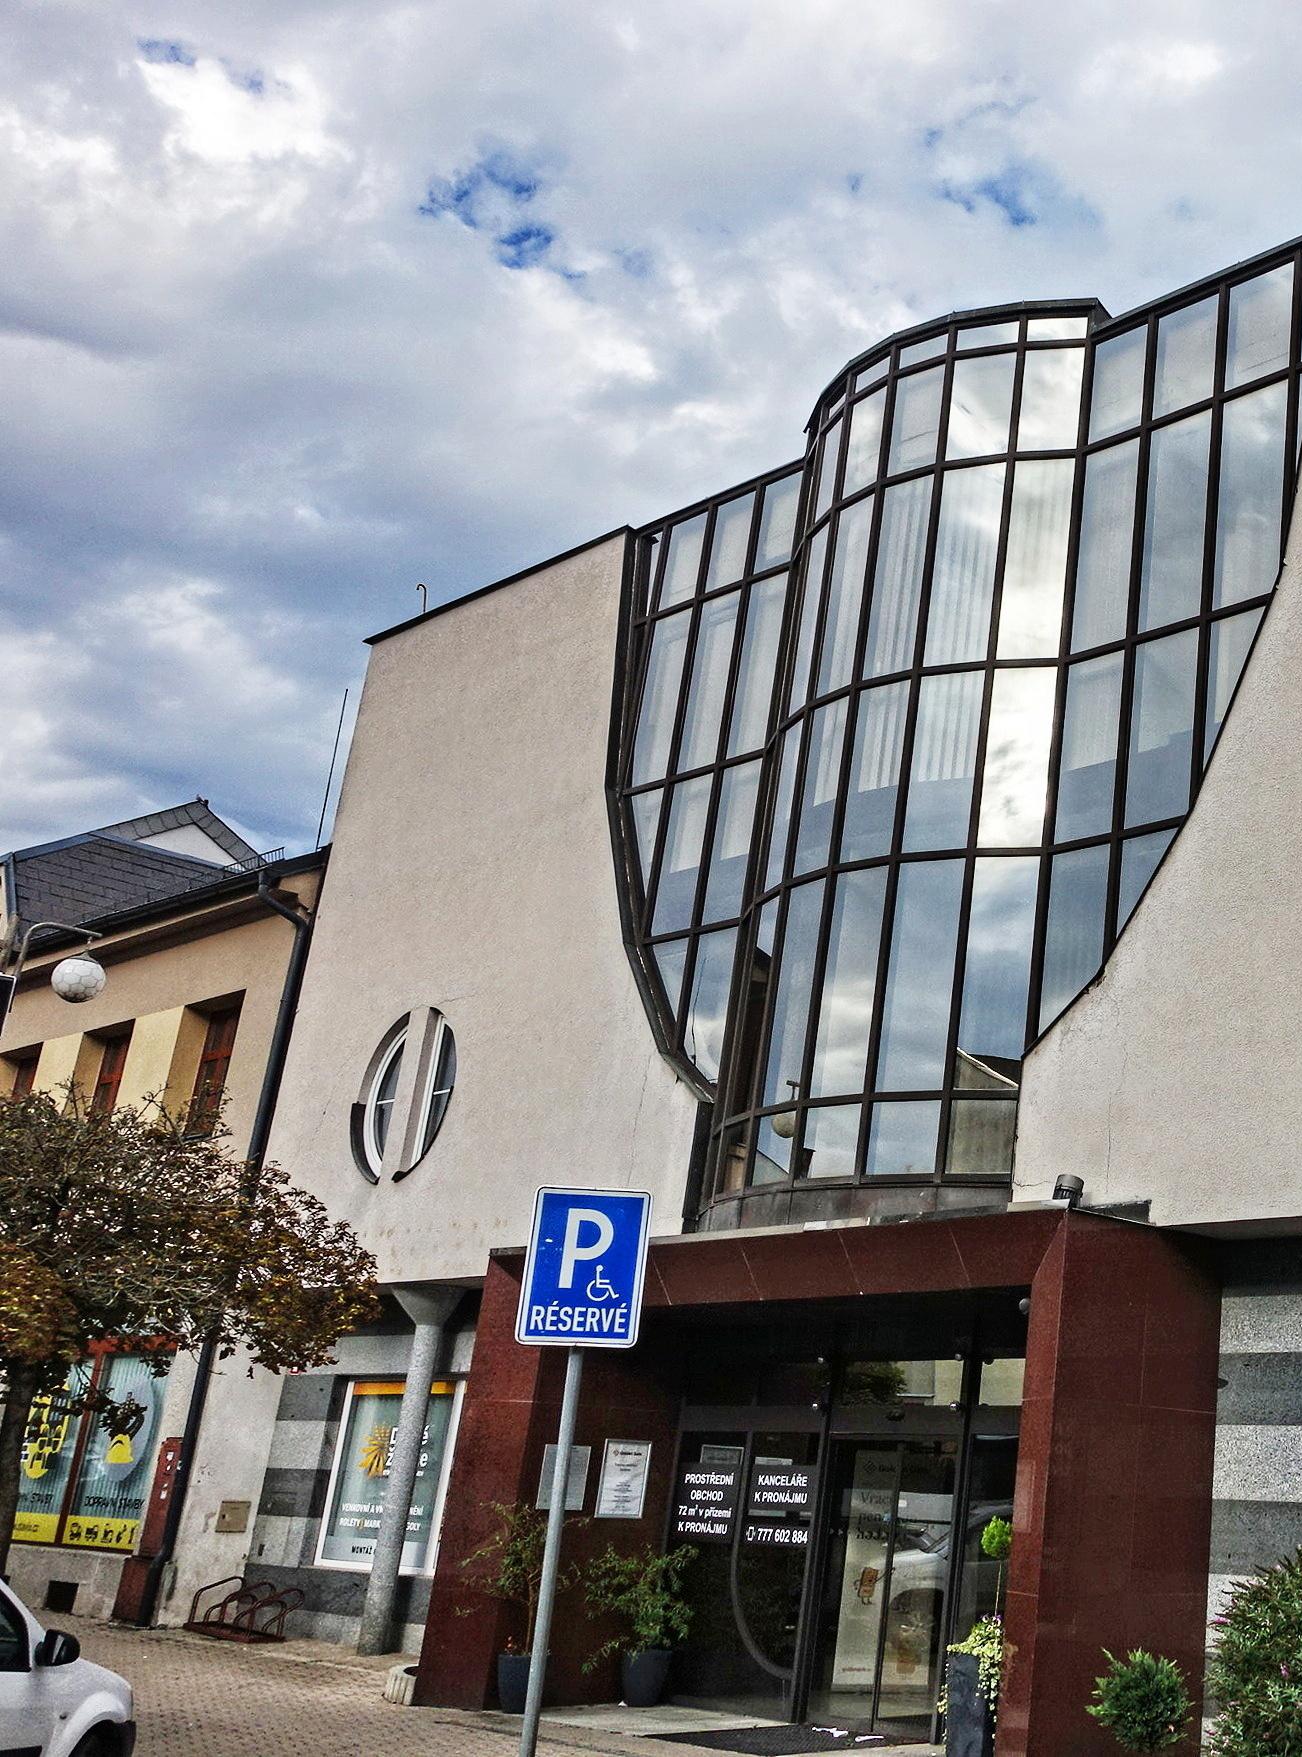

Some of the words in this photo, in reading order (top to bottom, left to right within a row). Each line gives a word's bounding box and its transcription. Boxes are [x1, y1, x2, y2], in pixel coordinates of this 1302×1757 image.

[557, 1207, 615, 1289] P
[529, 1300, 628, 1333] RÉSERVÉ
[684, 1472, 735, 1486] PROSTŘEDNÍ
[758, 1473, 808, 1487] KANCELÁŘE
[690, 1489, 724, 1502] OBCHOD
[754, 1491, 761, 1503] K
[762, 1490, 808, 1504] PRONÁJMU
[678, 1505, 688, 1516] 72
[699, 1508, 704, 1516] v
[704, 1506, 732, 1519] přízemí
[677, 1521, 684, 1532] K
[685, 1521, 728, 1534] PRONÁJMU
[757, 1527, 774, 1542] 777
[774, 1529, 791, 1543] 602
[791, 1530, 808, 1544] 884
